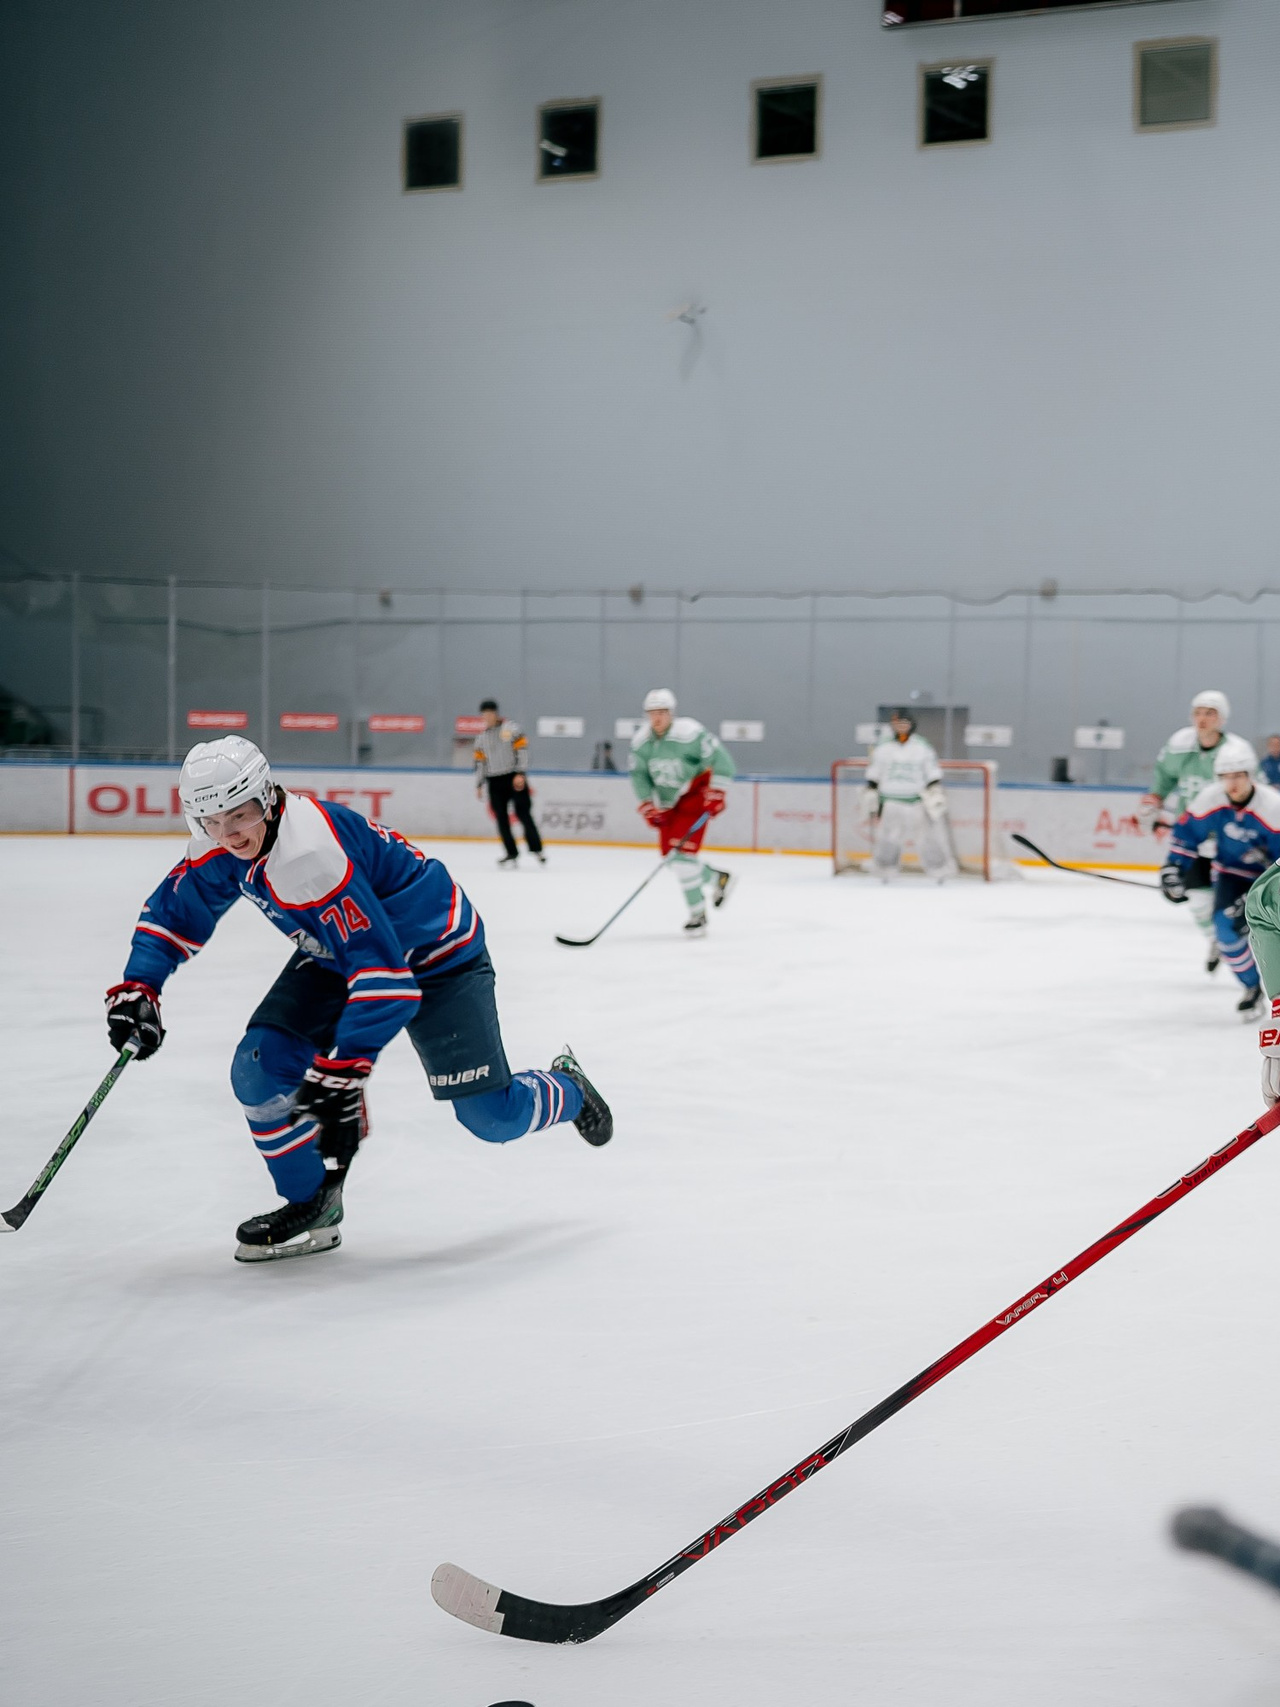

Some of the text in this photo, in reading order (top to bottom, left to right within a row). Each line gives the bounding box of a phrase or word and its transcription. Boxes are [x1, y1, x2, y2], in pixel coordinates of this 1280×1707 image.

[194, 793, 218, 803] CCM
[319, 895, 372, 943] 74
[430, 1065, 490, 1087] BAUER
[995, 1292, 1048, 1325] VAPOR
[680, 1453, 830, 1561] VAPOR
